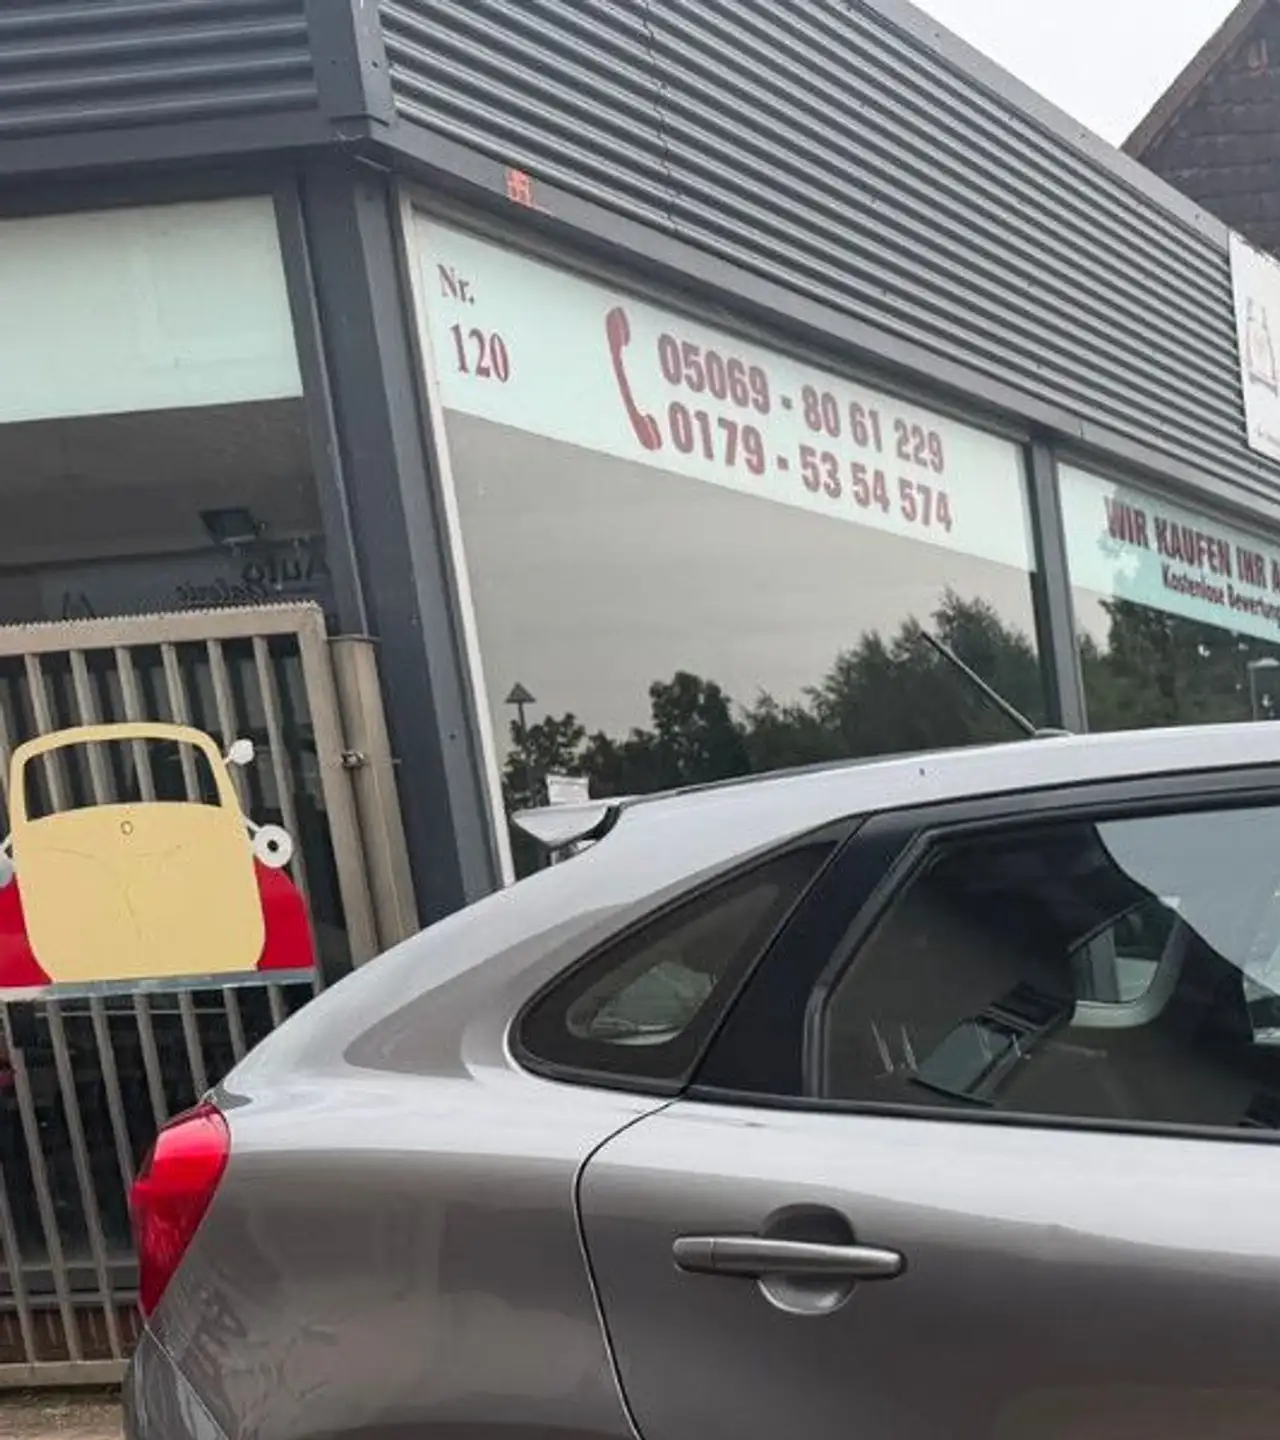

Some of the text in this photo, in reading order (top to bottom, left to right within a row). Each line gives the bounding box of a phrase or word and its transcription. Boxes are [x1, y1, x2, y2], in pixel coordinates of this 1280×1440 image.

[436, 263, 475, 304] Nr.
[449, 323, 510, 383] 120
[656, 332, 771, 415] 05069
[801, 383, 842, 438] 80
[849, 401, 883, 453] 61
[893, 417, 944, 475] 229
[667, 400, 766, 476] 0179
[799, 443, 842, 499] 53
[850, 461, 891, 514] 54
[898, 476, 952, 532] 574
[1104, 496, 1150, 549] WIR
[1153, 516, 1232, 578] KAUFEN
[1236, 547, 1267, 589] IHR
[1161, 561, 1225, 606] Kostenlose
